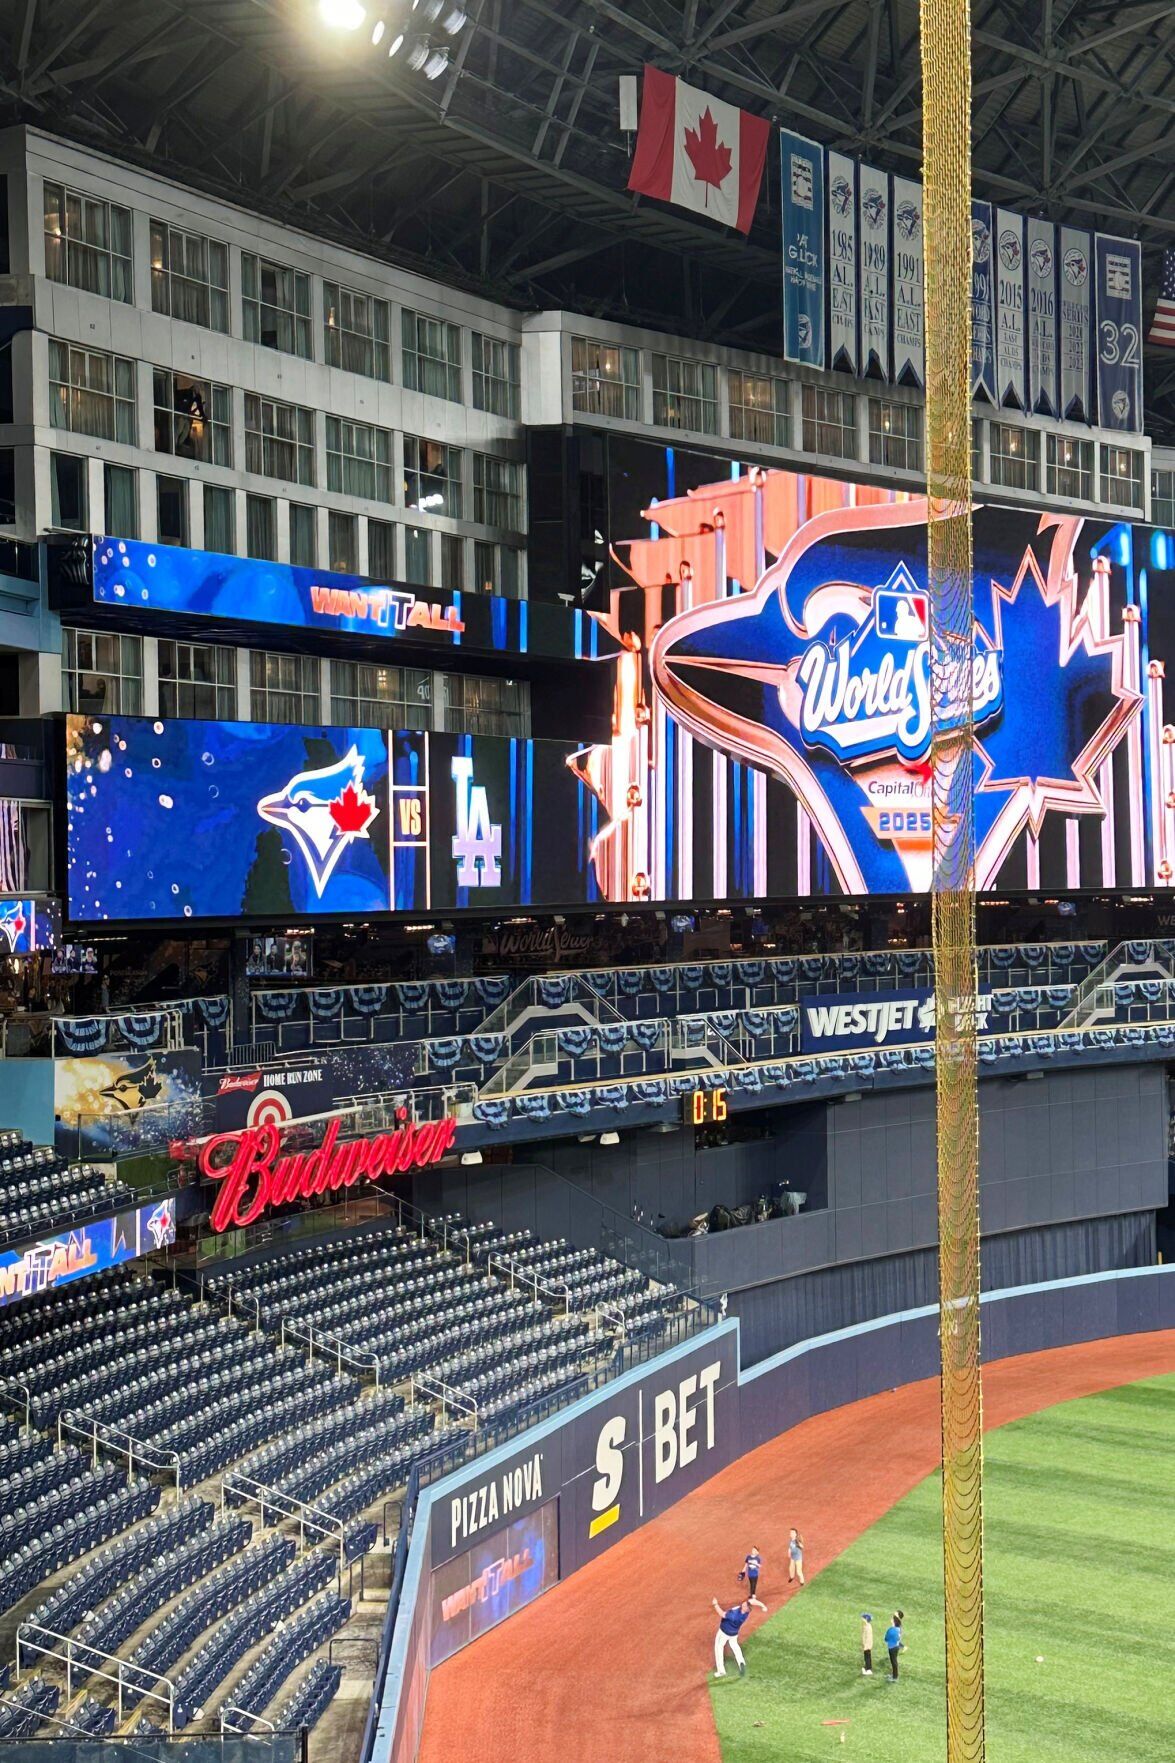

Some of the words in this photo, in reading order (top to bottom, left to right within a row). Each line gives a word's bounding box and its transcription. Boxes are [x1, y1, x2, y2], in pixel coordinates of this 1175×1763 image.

[832, 229, 854, 262] 1985
[864, 240, 885, 272] 1989
[897, 251, 919, 284] 1991
[897, 284, 920, 307] A.L.
[999, 279, 1022, 310] 2015
[1031, 287, 1053, 317] 2016
[897, 307, 920, 333] EAST
[1100, 320, 1139, 368] 32
[310, 586, 387, 621] WANT
[377, 590, 415, 630] IT
[406, 601, 465, 632] ALL
[800, 637, 914, 733] World
[896, 640, 1000, 747] Ses
[867, 780, 914, 797] Capital
[398, 798, 421, 836] VS
[450, 756, 502, 887] LA
[879, 812, 932, 831] 2025
[806, 1000, 918, 1043] WESTJET
[263, 1073, 286, 1088] HOME
[287, 1072, 302, 1085] RUN
[303, 1069, 323, 1083] ZONE
[693, 1087, 727, 1125] 0:15
[199, 1105, 457, 1234] Budweiser
[48, 1238, 98, 1282] ALL
[591, 1415, 627, 1512] S
[655, 1360, 721, 1484] BET
[451, 1481, 499, 1548] PIZZA
[502, 1453, 543, 1515] NOVA
[441, 1576, 487, 1622] WANT
[500, 1547, 534, 1587] ALL
